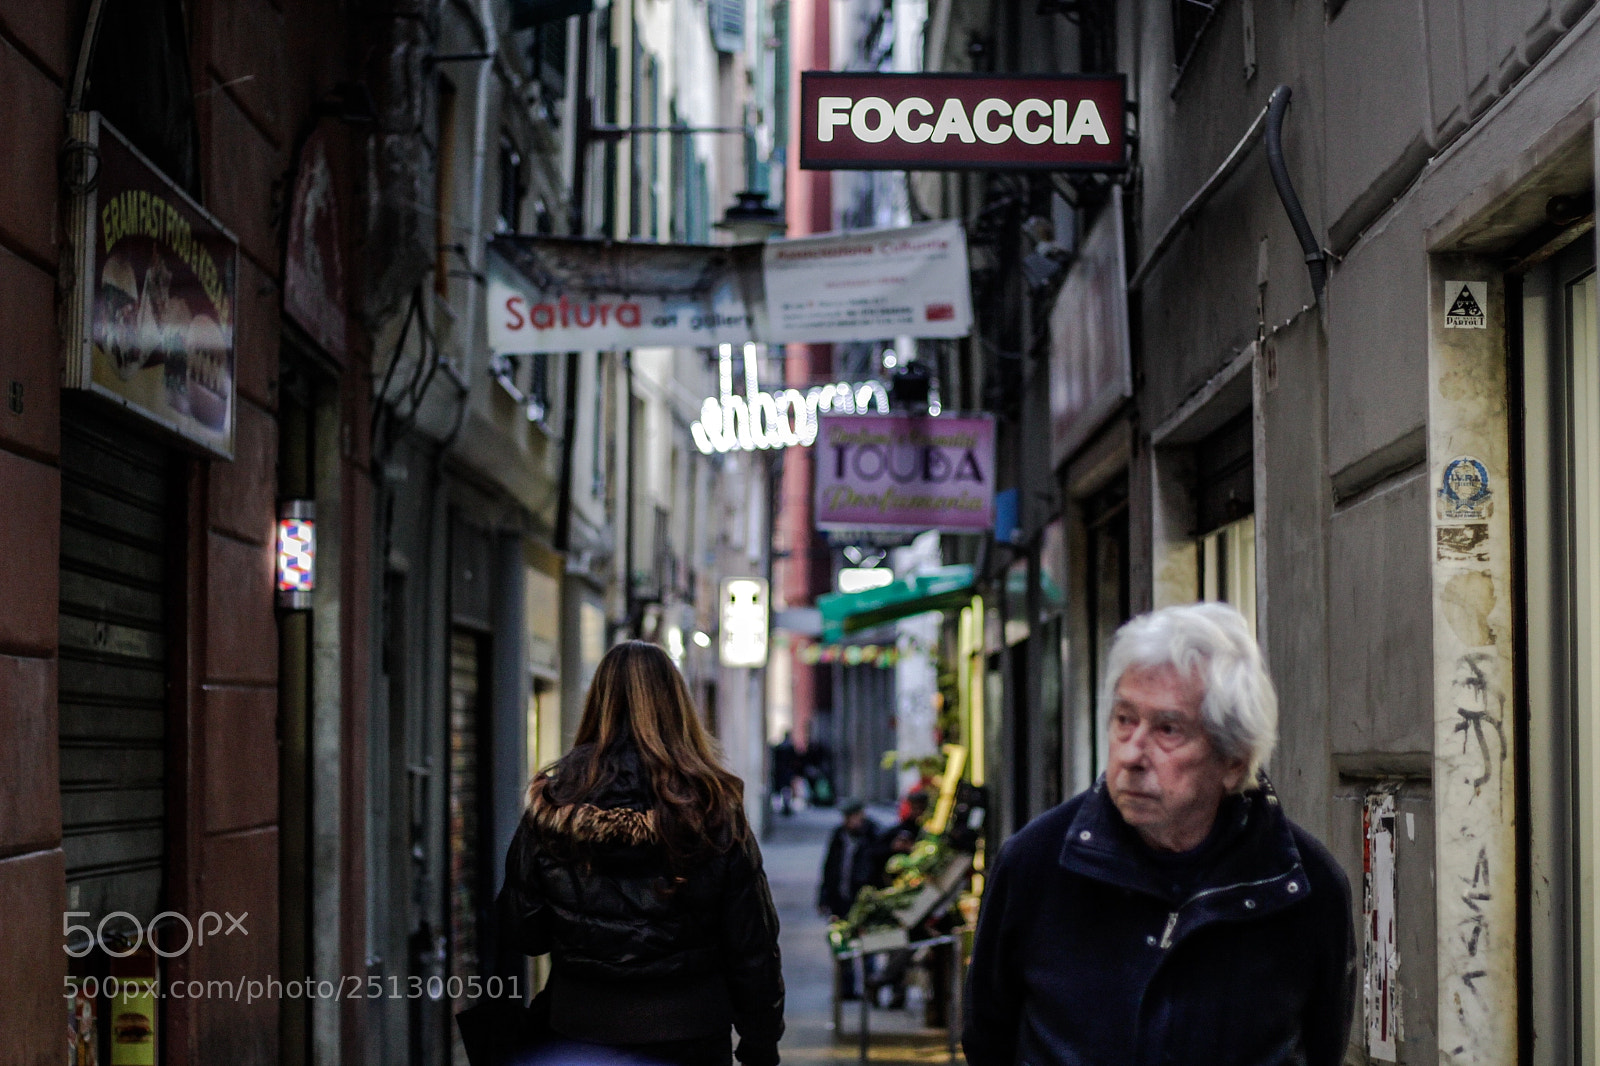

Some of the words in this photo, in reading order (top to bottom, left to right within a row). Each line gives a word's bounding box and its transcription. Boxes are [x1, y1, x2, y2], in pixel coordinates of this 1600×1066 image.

[817, 96, 1110, 144] FOCACCIA
[139, 190, 165, 242] FAST
[506, 295, 641, 330] Satura
[832, 441, 984, 484] TOUBA
